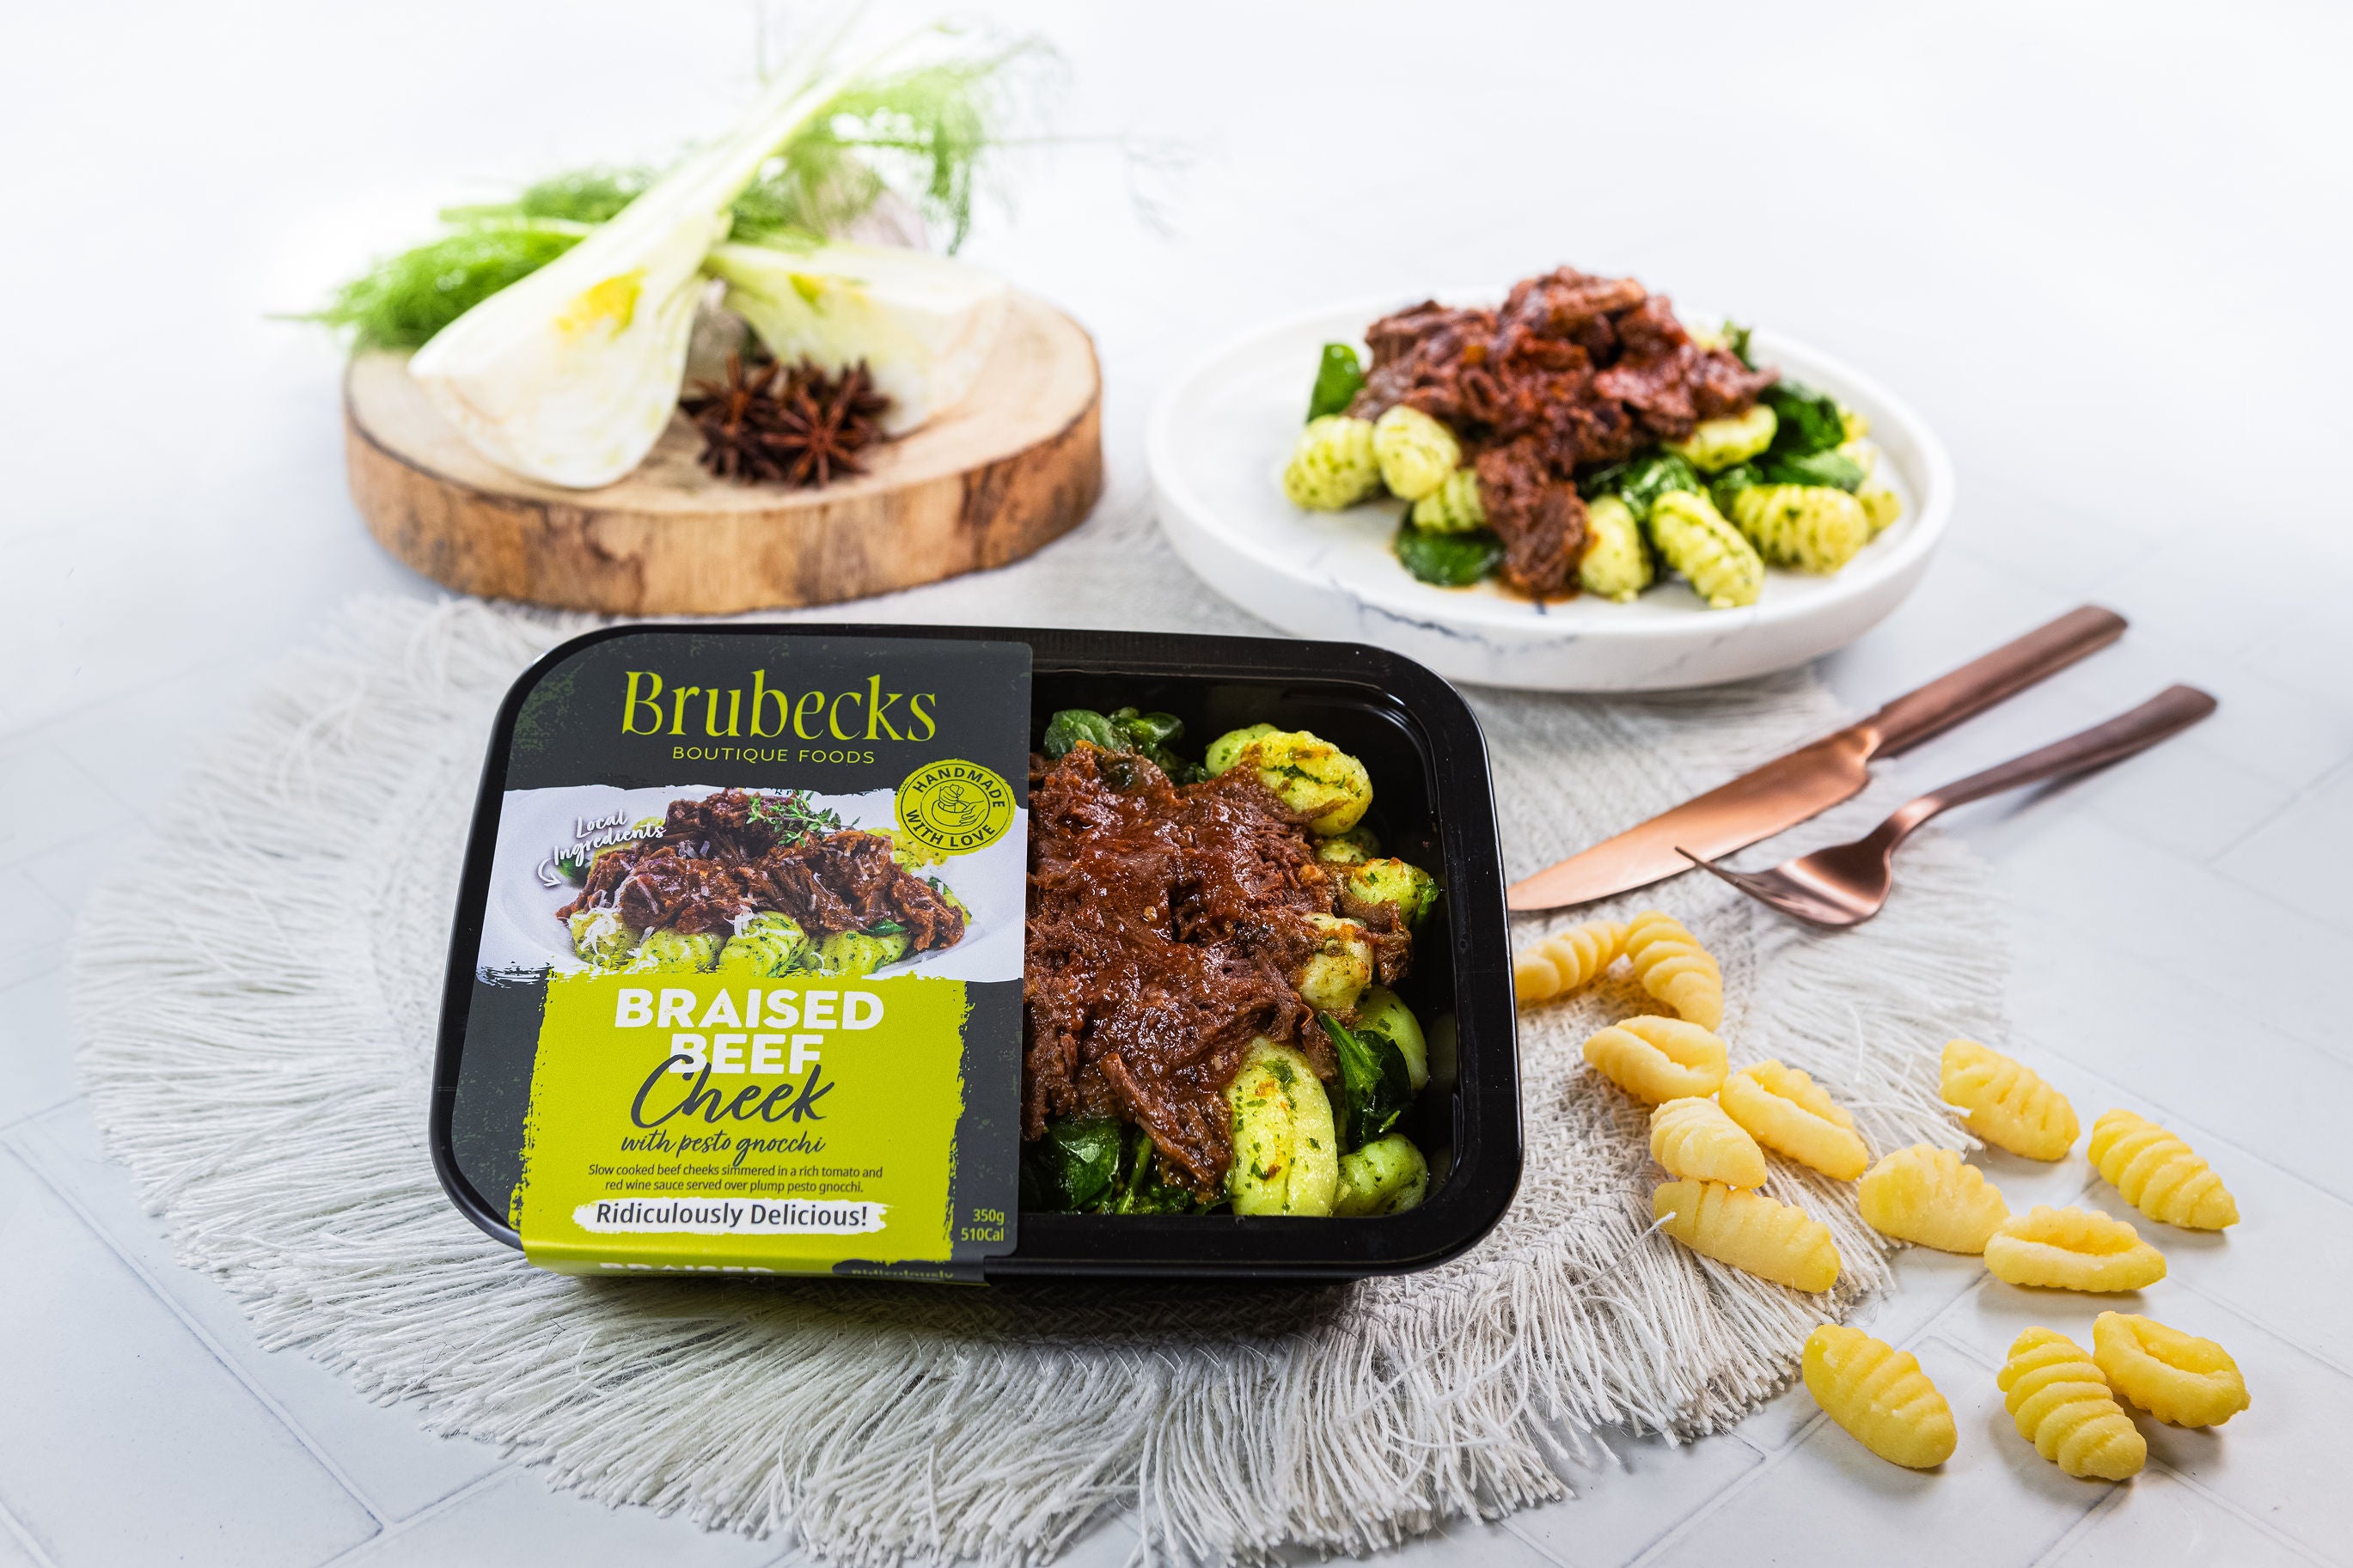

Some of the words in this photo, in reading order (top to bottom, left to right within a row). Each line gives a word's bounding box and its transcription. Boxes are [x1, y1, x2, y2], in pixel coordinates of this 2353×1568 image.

[621, 669, 938, 741] Brubecks
[672, 746, 789, 763] BOUTIQUE
[798, 749, 875, 765] FOODS
[912, 767, 1005, 808] HANDMADE
[576, 808, 628, 839] Local
[906, 808, 944, 845] WITH
[950, 824, 995, 847] LOVE
[553, 822, 667, 868] Ingredients
[614, 988, 884, 1030] BRAISED
[669, 1034, 822, 1075] BEEF
[630, 1053, 834, 1129] Cheek
[620, 1129, 677, 1153] with
[675, 1130, 731, 1158] pesto
[732, 1131, 826, 1168] gnocchi
[588, 1164, 614, 1175] Slow
[616, 1164, 654, 1175] cooked
[657, 1164, 681, 1175] beef
[682, 1165, 719, 1175] cheeks
[721, 1165, 775, 1176] simmered
[778, 1167, 788, 1176] in
[798, 1166, 819, 1177] rich
[822, 1168, 860, 1178] tomato
[862, 1167, 883, 1178] and
[605, 1180, 624, 1190] red
[626, 1180, 651, 1191] wine
[653, 1182, 683, 1191] sauce
[686, 1180, 722, 1191] served
[724, 1182, 749, 1191] over
[749, 1181, 785, 1193] plump
[786, 1182, 816, 1194] pesto
[819, 1181, 864, 1194] gnocchi.
[596, 1202, 744, 1229] Ridiculously
[750, 1204, 868, 1227] Delicious!
[961, 1227, 1005, 1242] 510Cal
[973, 1208, 1005, 1226] 350g
